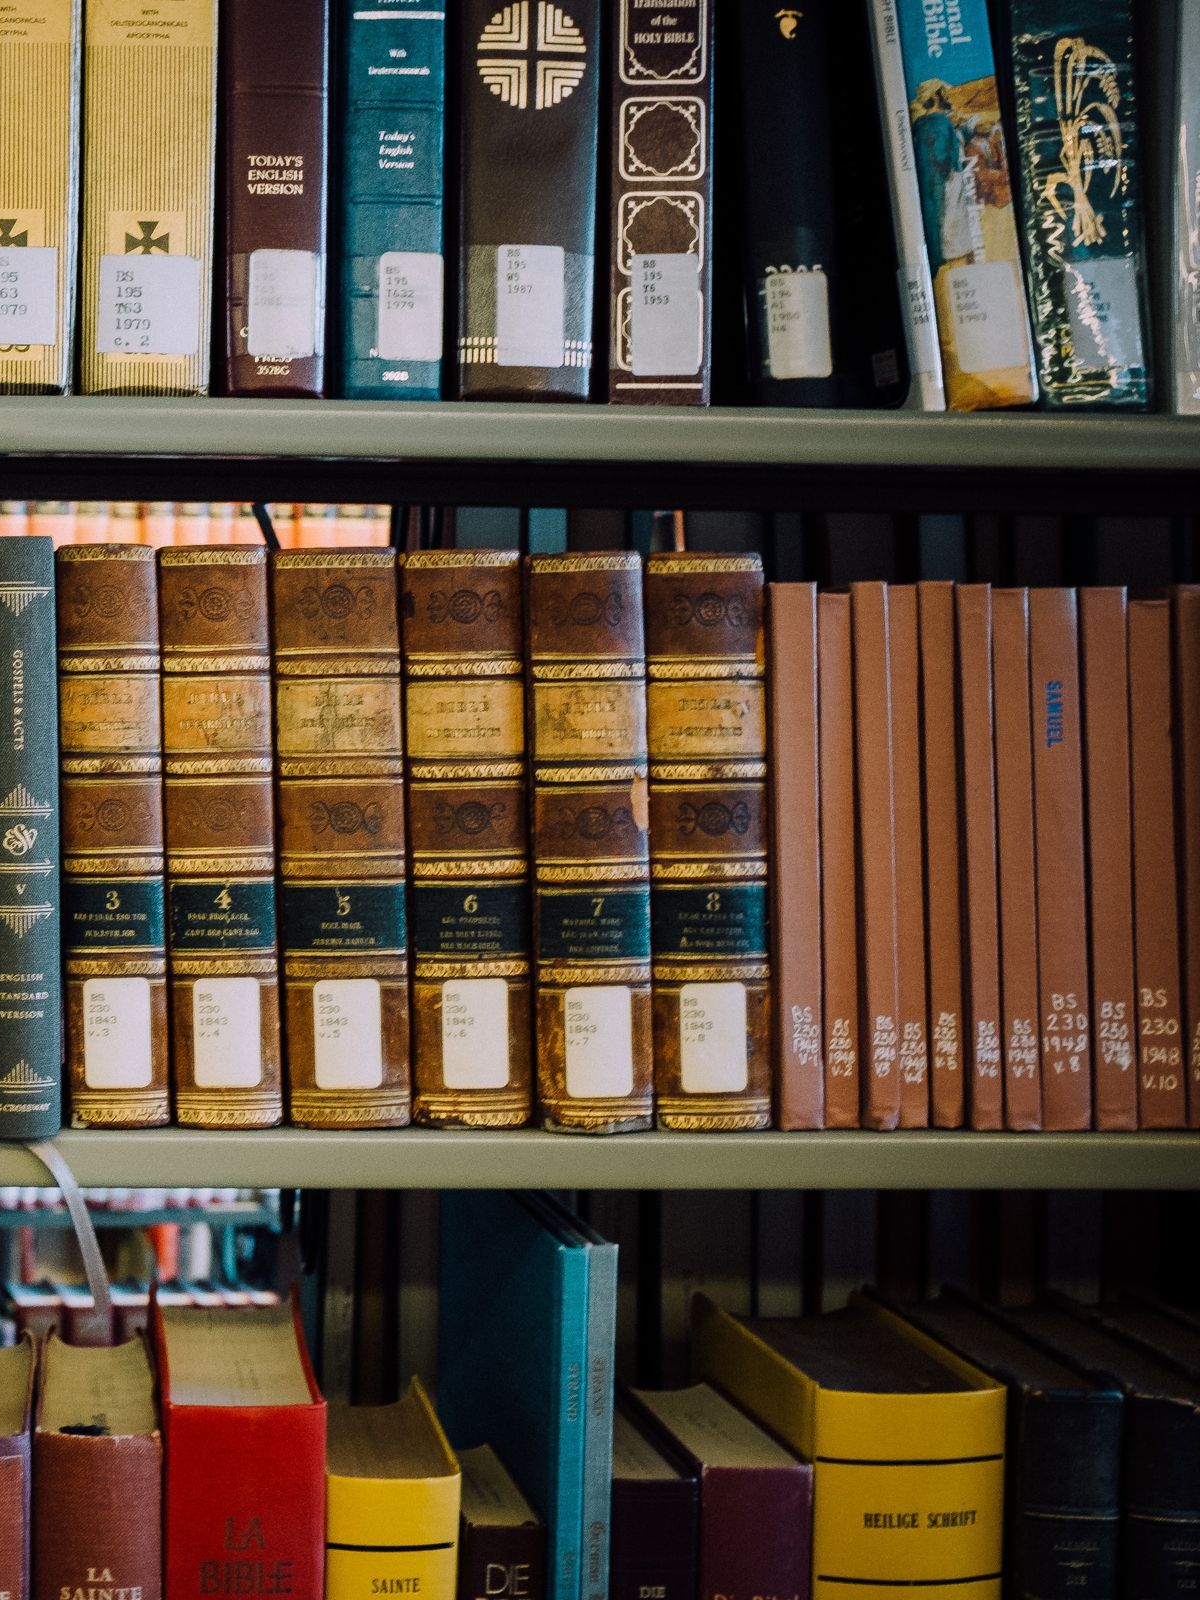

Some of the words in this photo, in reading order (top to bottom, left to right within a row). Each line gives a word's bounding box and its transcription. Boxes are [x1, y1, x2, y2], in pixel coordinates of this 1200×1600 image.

[651, 15, 660, 26] of
[663, 15, 677, 26] the
[634, 33, 662, 44] HOLY
[664, 33, 694, 43] BIBLE
[378, 131, 415, 142] Today's
[379, 145, 413, 156] English
[247, 155, 303, 167] TODAY'S
[378, 159, 414, 169] Version
[248, 170, 303, 181] ENGLISH
[247, 184, 304, 195] VERSION
[116, 271, 134, 282] BS
[116, 287, 142, 298] 195
[508, 285, 532, 293] 1987
[115, 303, 142, 313] T63
[386, 301, 414, 310] 1979
[115, 318, 151, 330] 1979
[13, 650, 23, 704] GOSPELS
[14, 707, 23, 715] &
[1046, 681, 1063, 748] SAMUEL
[14, 719, 24, 750] ACTS
[16, 884, 26, 895] V
[106, 890, 120, 910] 3
[214, 889, 232, 910] 4
[336, 895, 350, 916] 5
[463, 894, 478, 913] 6
[591, 897, 605, 917] 7
[706, 892, 720, 911] 8
[0, 973, 43, 981] ENGLISH
[1052, 993, 1077, 1011] BS
[1140, 988, 1167, 1007] BS
[0, 1010, 44, 1019] VERSION
[1101, 1002, 1126, 1019] BS
[89, 1016, 117, 1024] 1843
[1047, 1014, 1088, 1031] 230
[1142, 1018, 1178, 1035] 230
[1100, 1023, 1128, 1039] 230
[1043, 1034, 1088, 1053] 1948
[1142, 1048, 1179, 1065] 1948
[864, 1513, 918, 1528] HEILIGE
[927, 1510, 976, 1528] SCHRIFT
[225, 1517, 266, 1550] LA
[88, 1568, 115, 1582] LA
[201, 1561, 293, 1594] BIBLE
[486, 1564, 530, 1595] DIE
[60, 1586, 142, 1600] SAINTE
[372, 1578, 420, 1594] SAINTE
